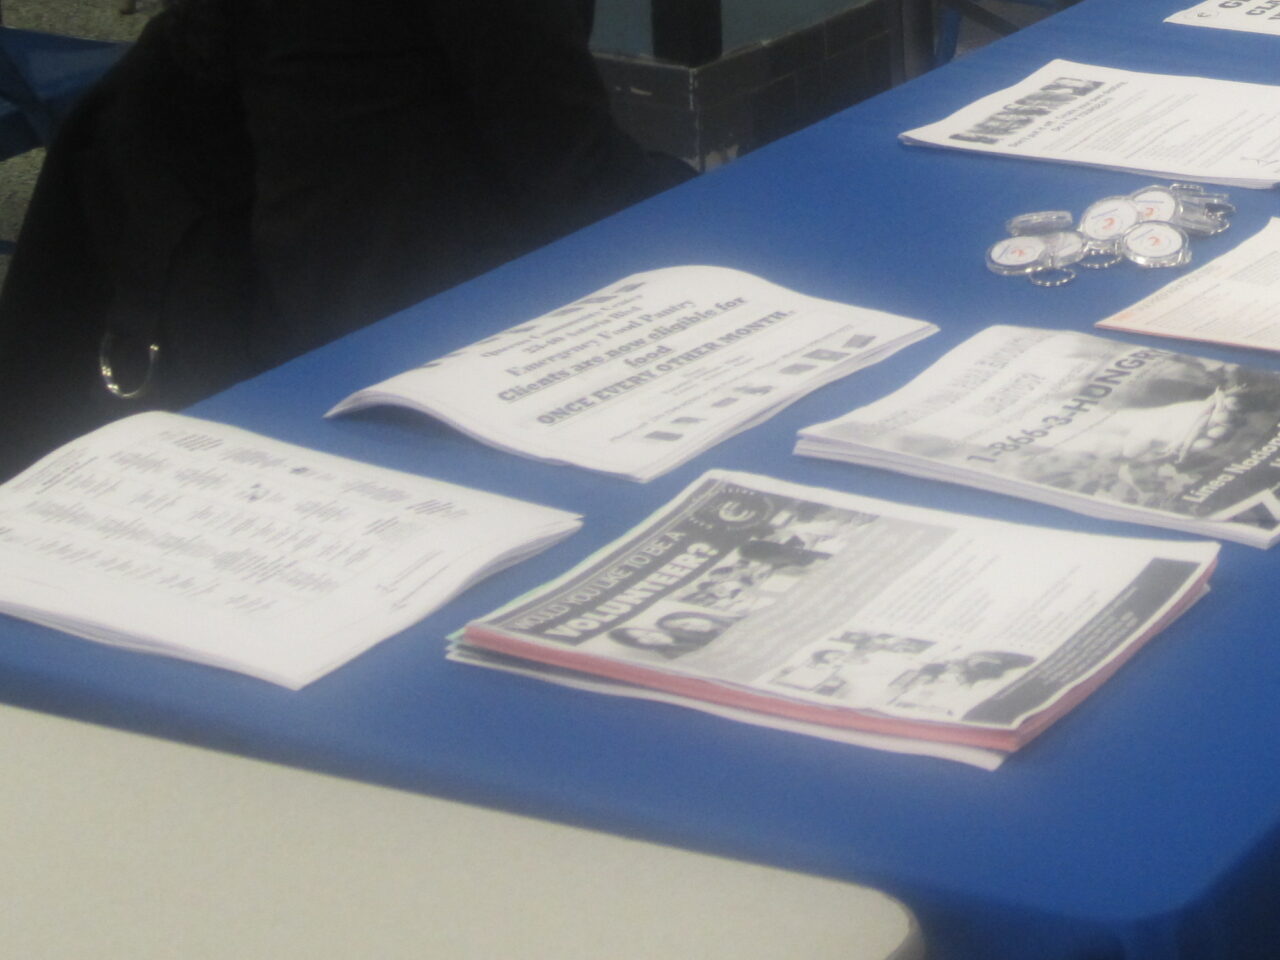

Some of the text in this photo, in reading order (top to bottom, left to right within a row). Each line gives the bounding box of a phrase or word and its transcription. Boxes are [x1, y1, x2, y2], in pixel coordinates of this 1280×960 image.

[494, 295, 748, 402] Clients are now eligible for
[503, 298, 699, 377] Emergency Food Pantry
[533, 396, 596, 426] ONCE
[589, 368, 661, 401] EVERY
[652, 340, 723, 373] OTHER
[620, 342, 675, 369] food
[506, 530, 689, 630] WOULD YOU LIKE TO BE A
[542, 540, 728, 639] VOLUNTEER?
